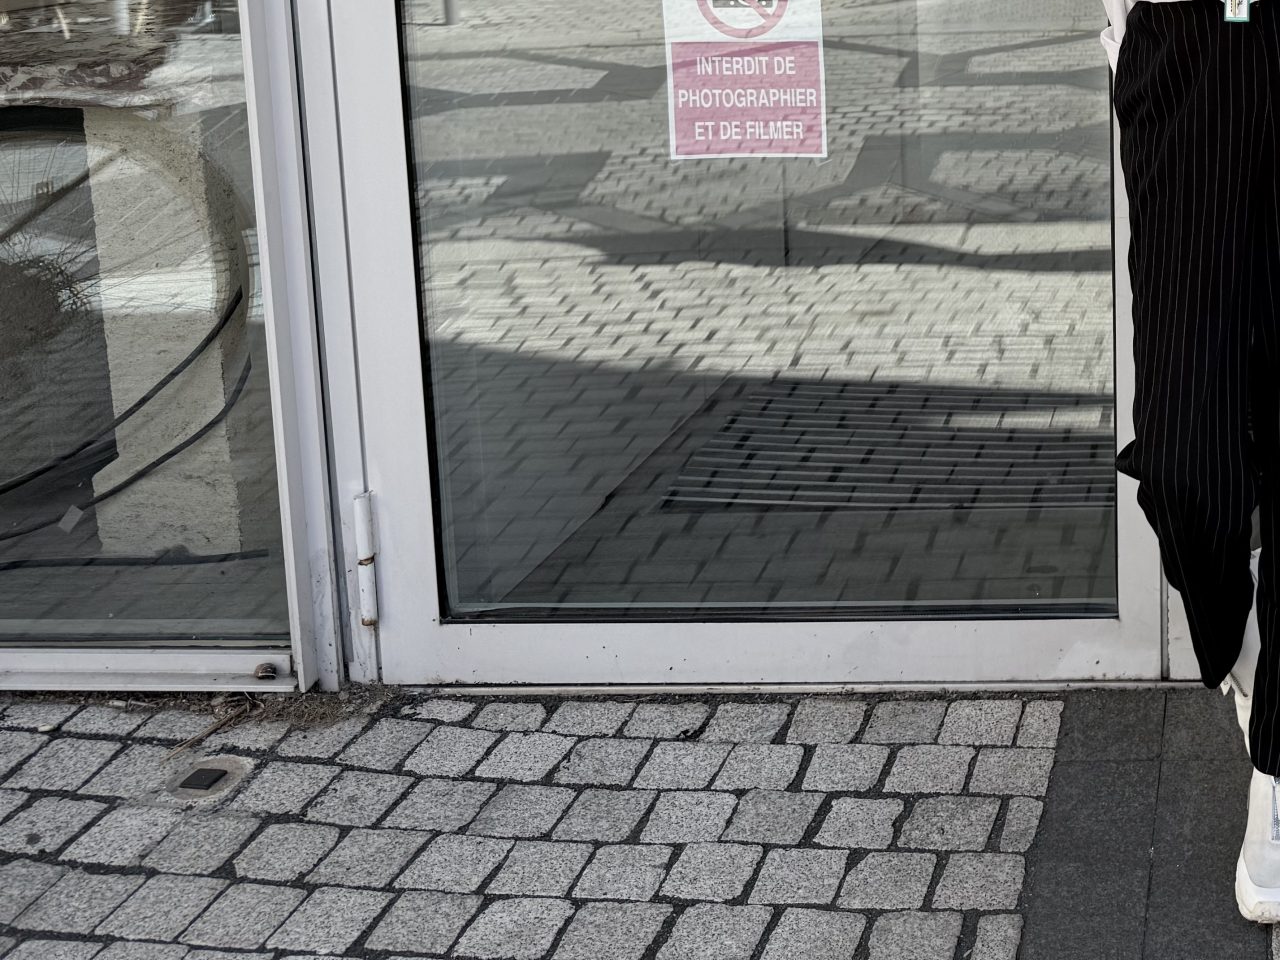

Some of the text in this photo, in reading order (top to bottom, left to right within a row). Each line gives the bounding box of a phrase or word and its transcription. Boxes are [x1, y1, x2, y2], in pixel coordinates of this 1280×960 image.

[696, 56, 796, 76] INTERDIT DE
[678, 88, 817, 108] PHOTOGRAPHIER
[694, 121, 804, 141] ET DE FILMER
